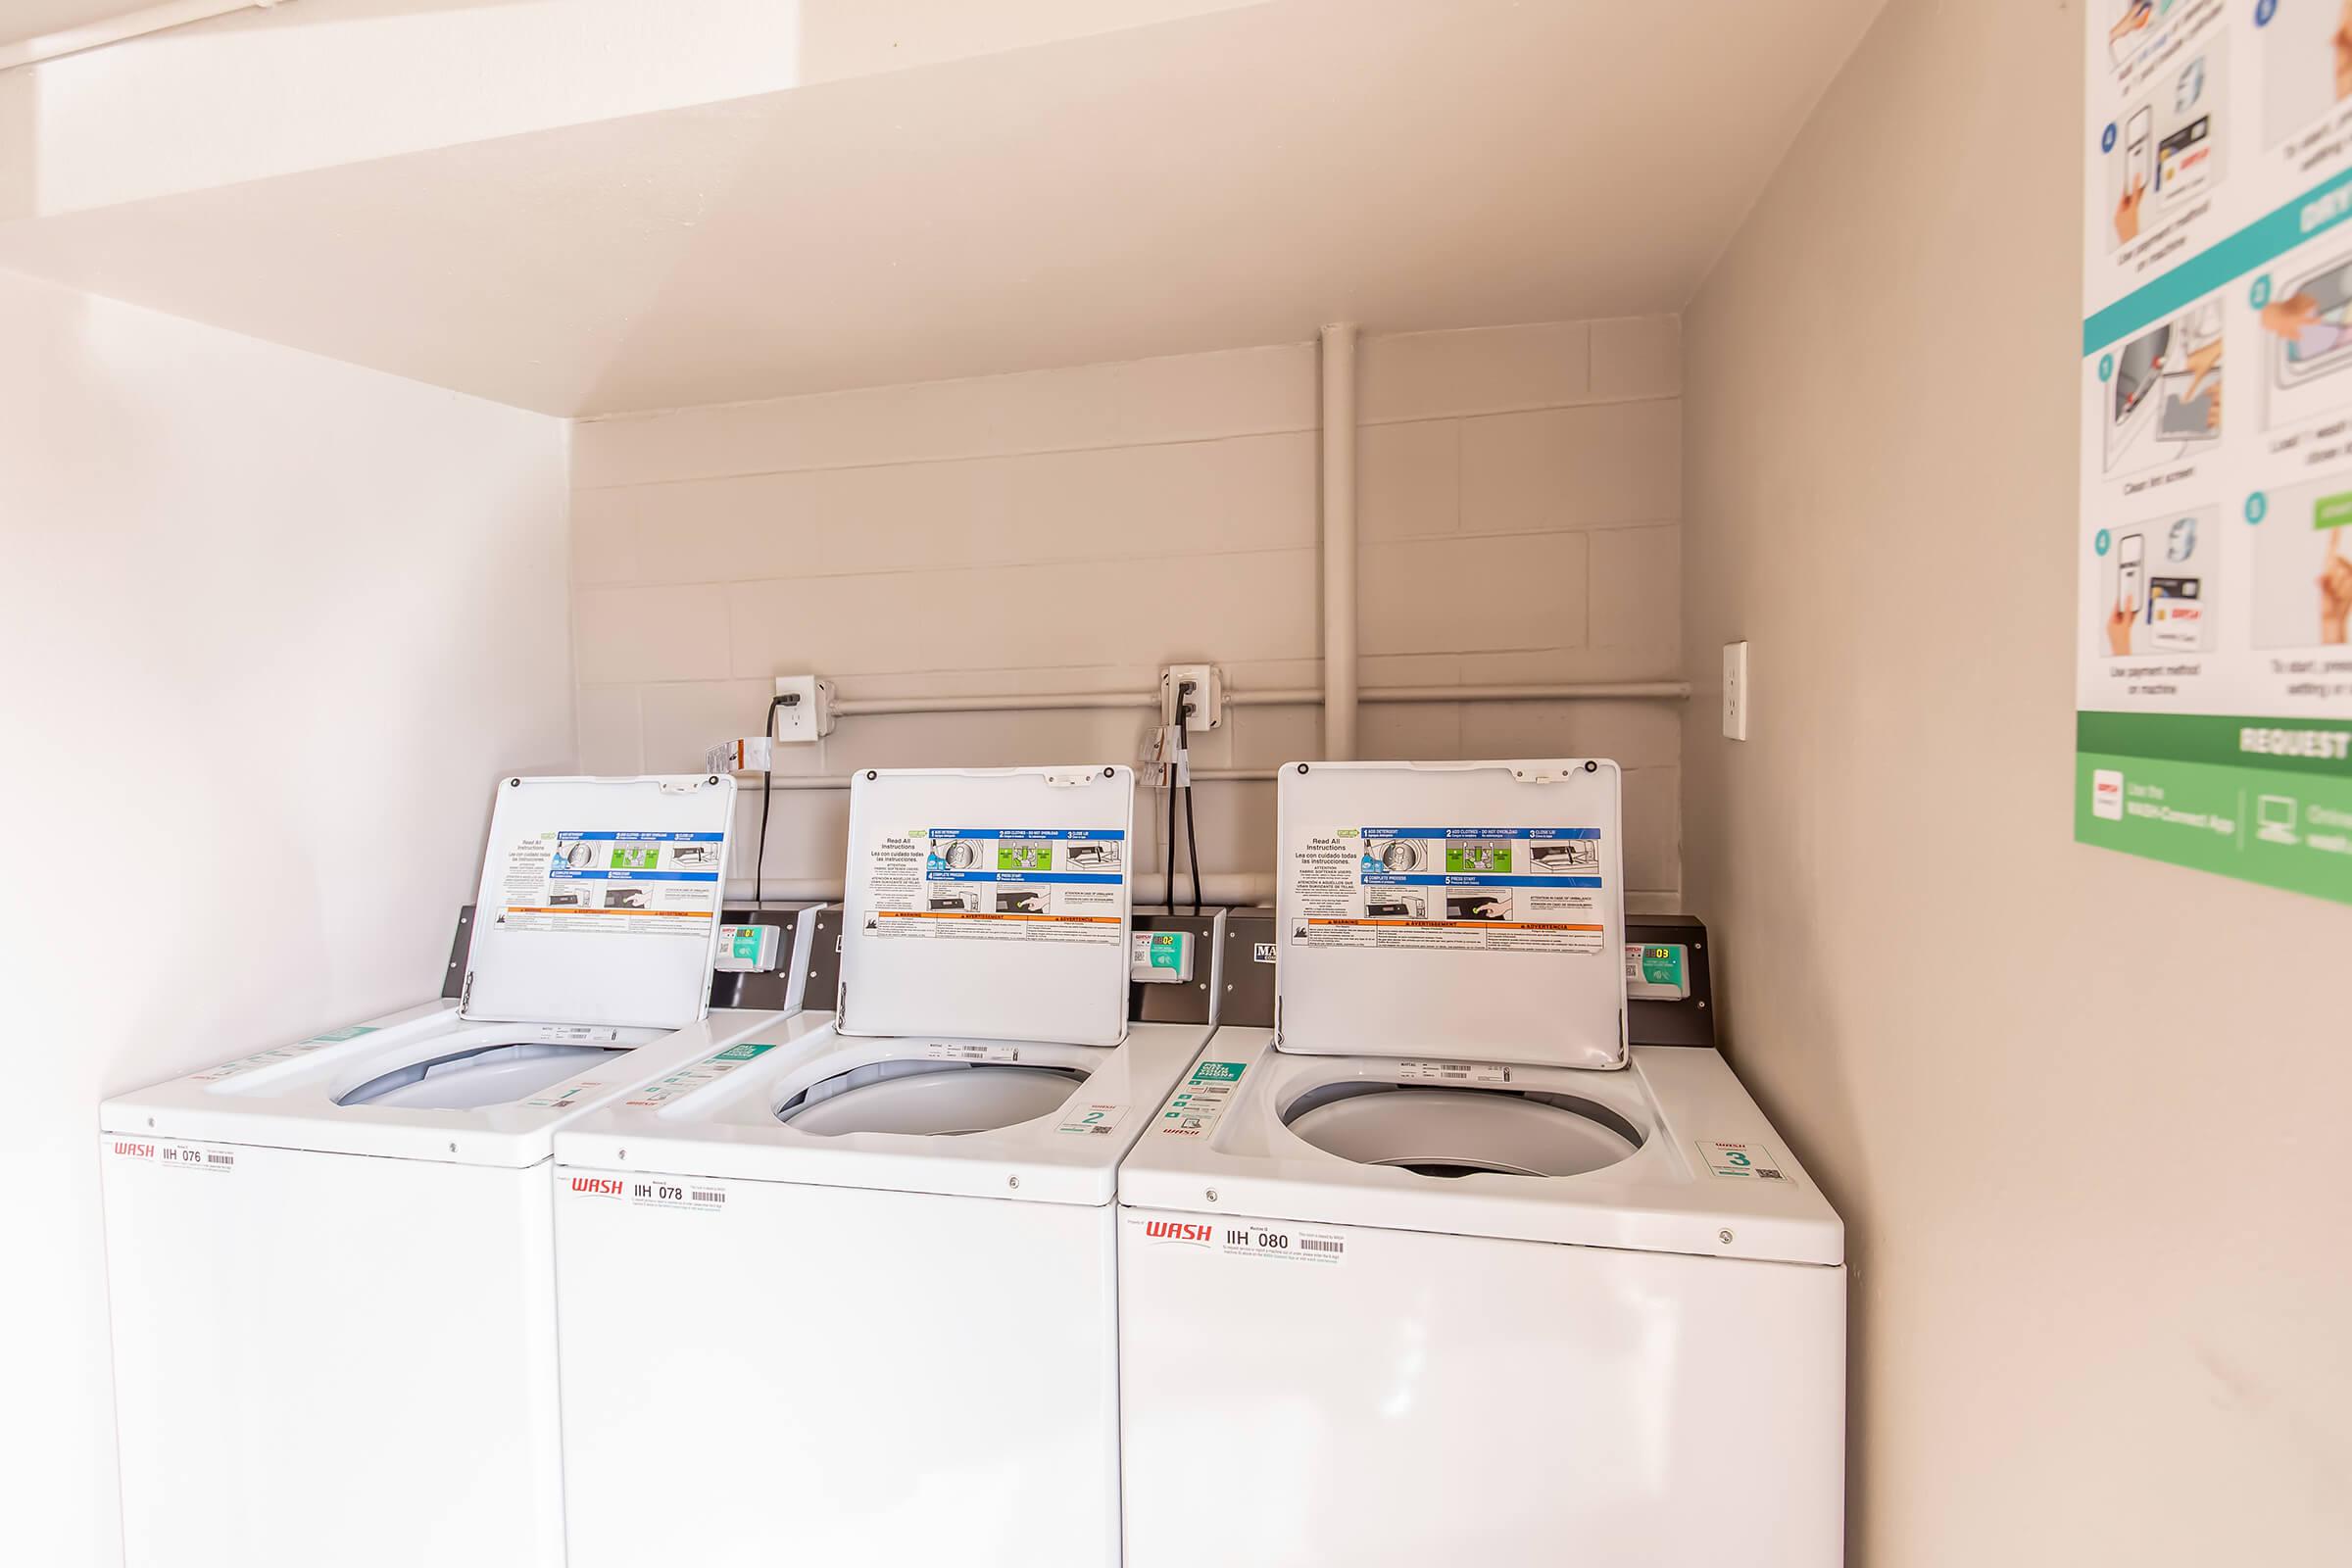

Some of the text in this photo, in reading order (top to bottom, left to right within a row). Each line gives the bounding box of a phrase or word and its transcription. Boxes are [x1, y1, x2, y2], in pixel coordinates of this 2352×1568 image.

[2239, 727, 2350, 760] REQUEST
[1656, 949, 1669, 958] 03
[1082, 1112, 1104, 1124] 2
[115, 1142, 155, 1157] WASH
[182, 1151, 201, 1162] 076
[1726, 1152, 1750, 1166] 3
[571, 1177, 682, 1200] WASH IIH 078
[1146, 1221, 1289, 1249] WASH IIH 080
